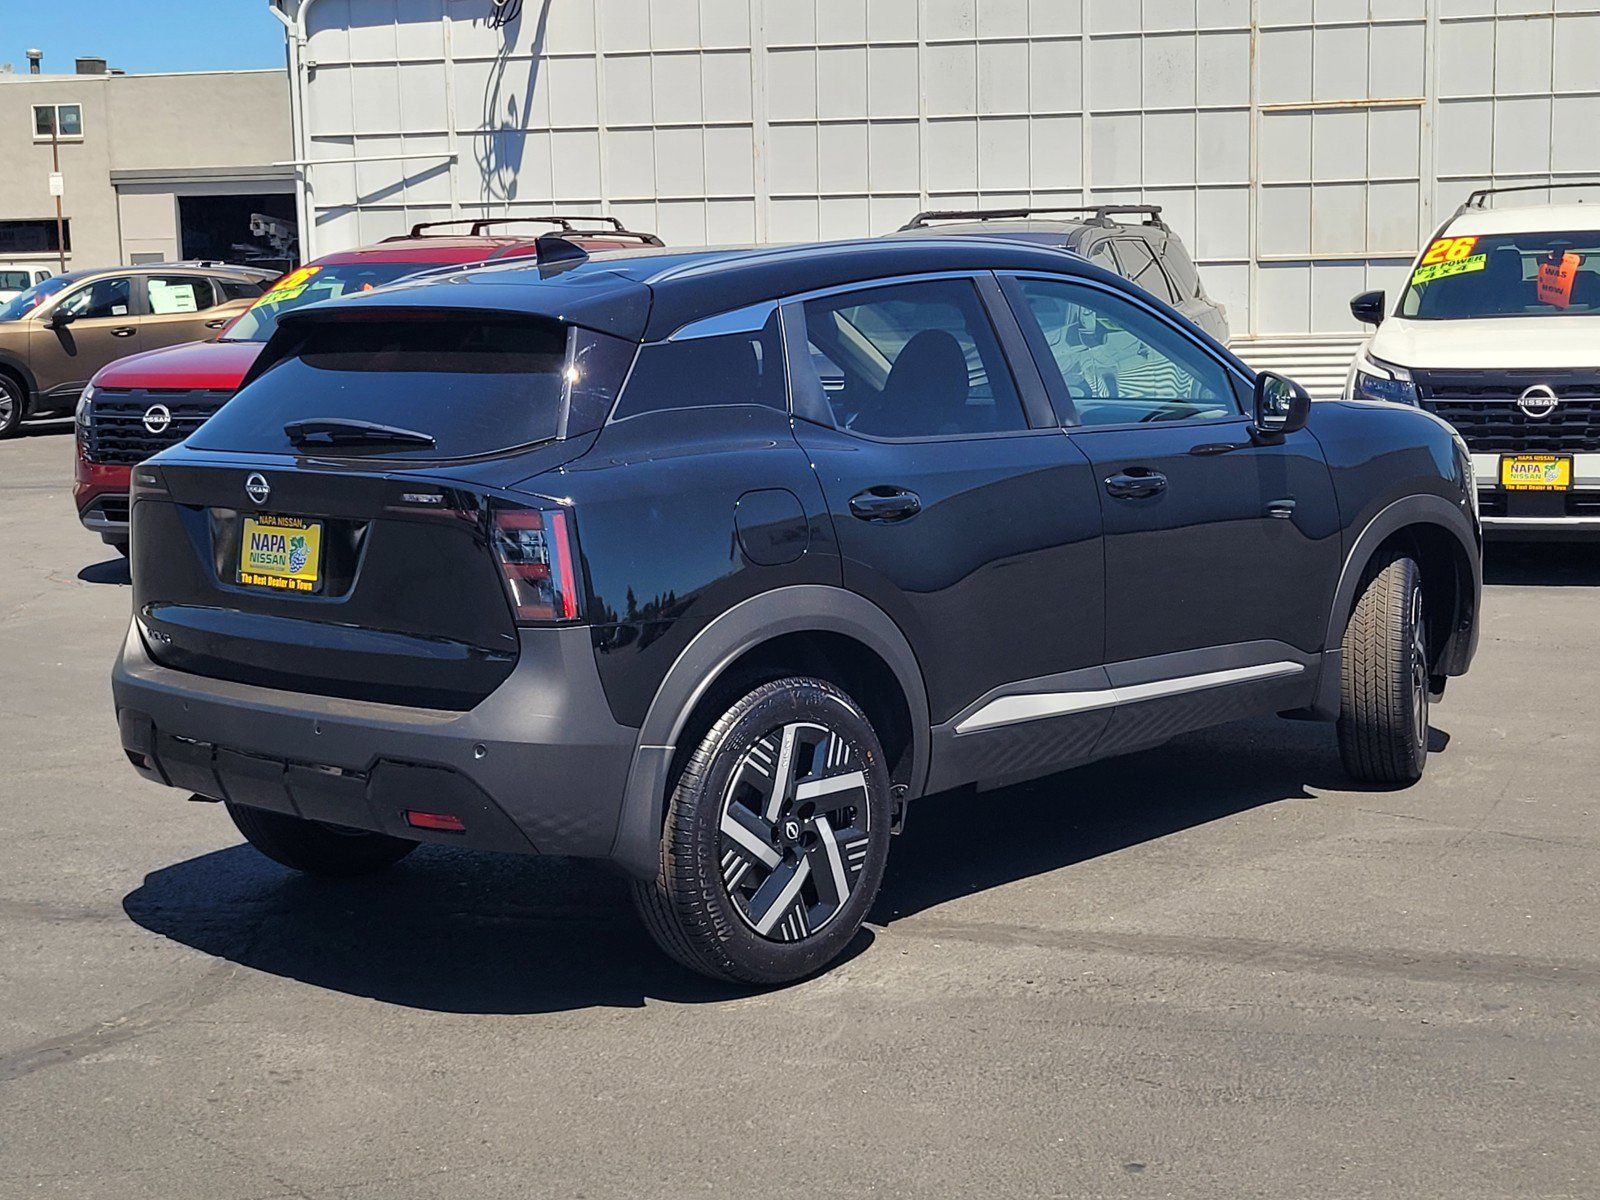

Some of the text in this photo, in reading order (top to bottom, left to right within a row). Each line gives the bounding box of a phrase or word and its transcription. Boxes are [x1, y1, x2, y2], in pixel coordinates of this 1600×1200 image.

[1421, 237, 1476, 266] 26
[1440, 255, 1483, 268] POWER
[1545, 268, 1567, 278] WAS
[1517, 398, 1558, 406] NISSAN
[1511, 464, 1541, 473] NAPA
[259, 515, 303, 528] NAPA NISSAN
[251, 533, 286, 553] NAPA
[250, 552, 286, 566] NISSAN
[241, 573, 313, 591] The Best Dealer in Town
